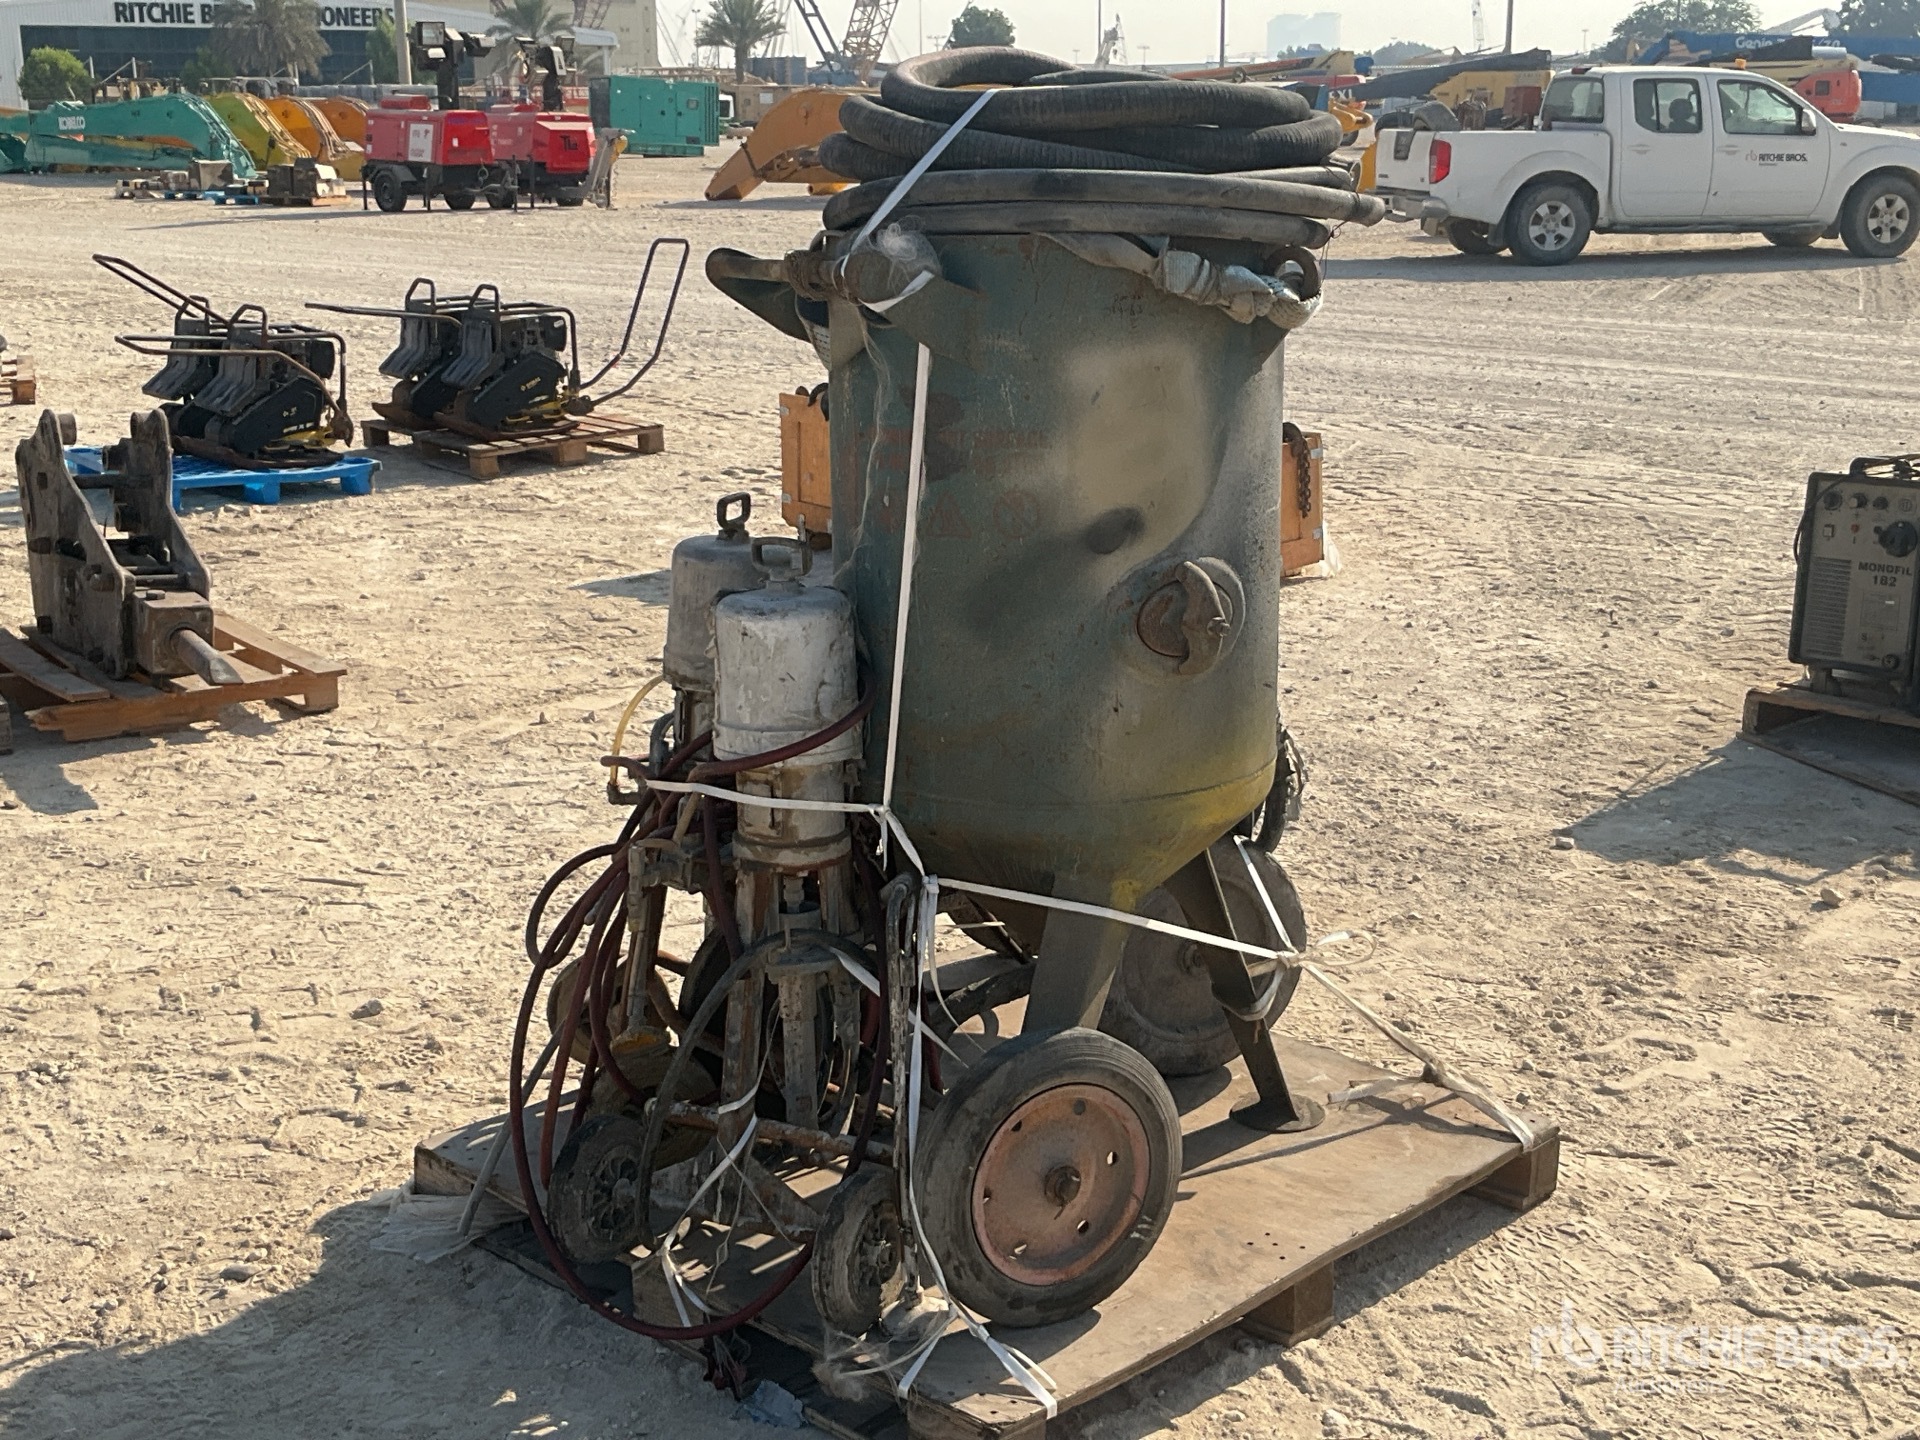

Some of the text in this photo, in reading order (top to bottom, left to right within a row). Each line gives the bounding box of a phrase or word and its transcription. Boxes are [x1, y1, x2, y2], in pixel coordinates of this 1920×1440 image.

[114, 2, 195, 23] RITCHIE
[1759, 153, 1784, 161] RITCHIE
[1873, 574, 1897, 587] 182
